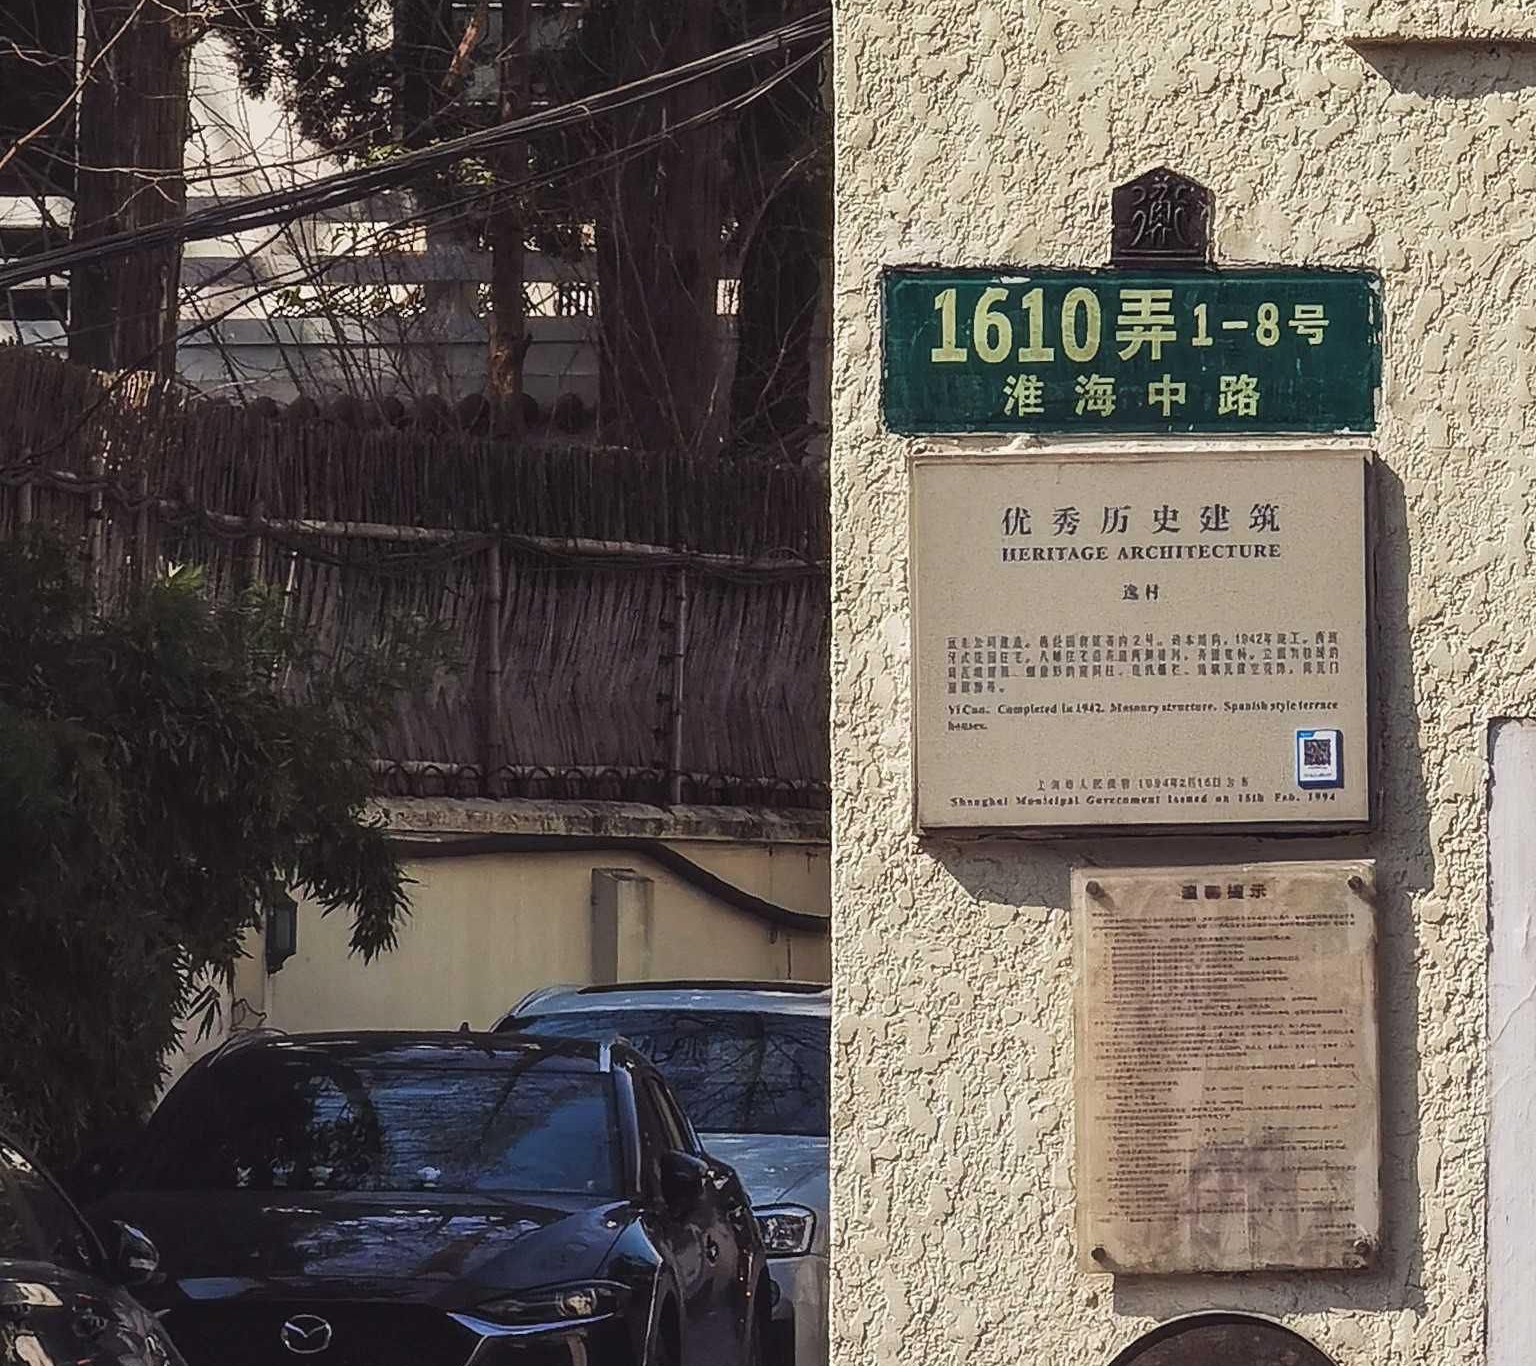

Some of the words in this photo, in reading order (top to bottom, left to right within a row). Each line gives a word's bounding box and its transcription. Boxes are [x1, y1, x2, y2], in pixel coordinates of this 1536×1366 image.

[1003, 373, 1260, 417] 淮海中路
[1001, 503, 1280, 536] 优秀历史建筑
[1002, 545, 1109, 563] HERITAGE
[1117, 543, 1281, 560] ARCHITECTURE
